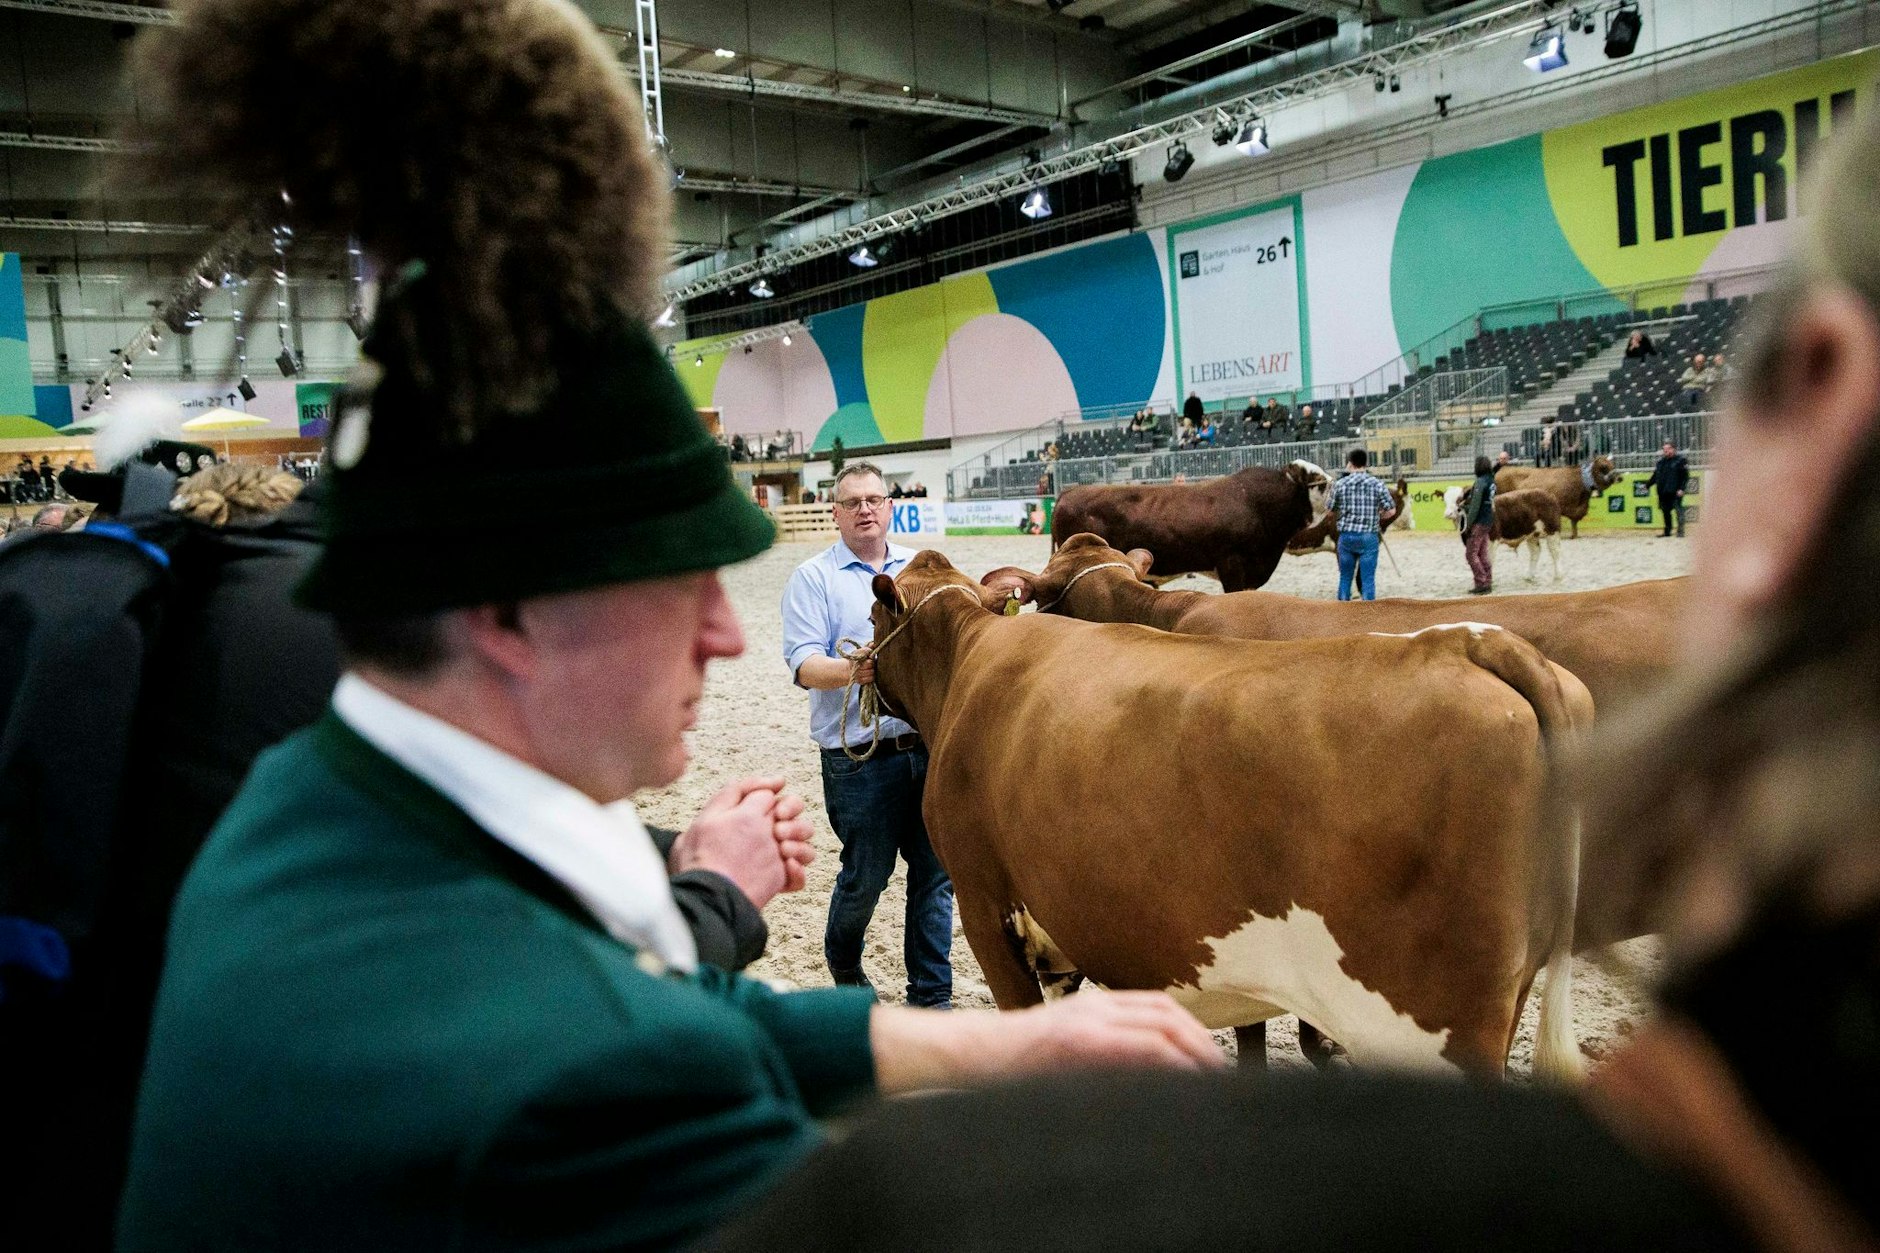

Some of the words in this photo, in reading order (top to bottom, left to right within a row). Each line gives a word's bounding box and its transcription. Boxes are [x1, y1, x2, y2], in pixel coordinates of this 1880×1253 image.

[1256, 245, 1277, 264] 26
[1190, 351, 1293, 384] LEBENSART
[1411, 490, 1435, 503] der
[887, 503, 921, 533] KB
